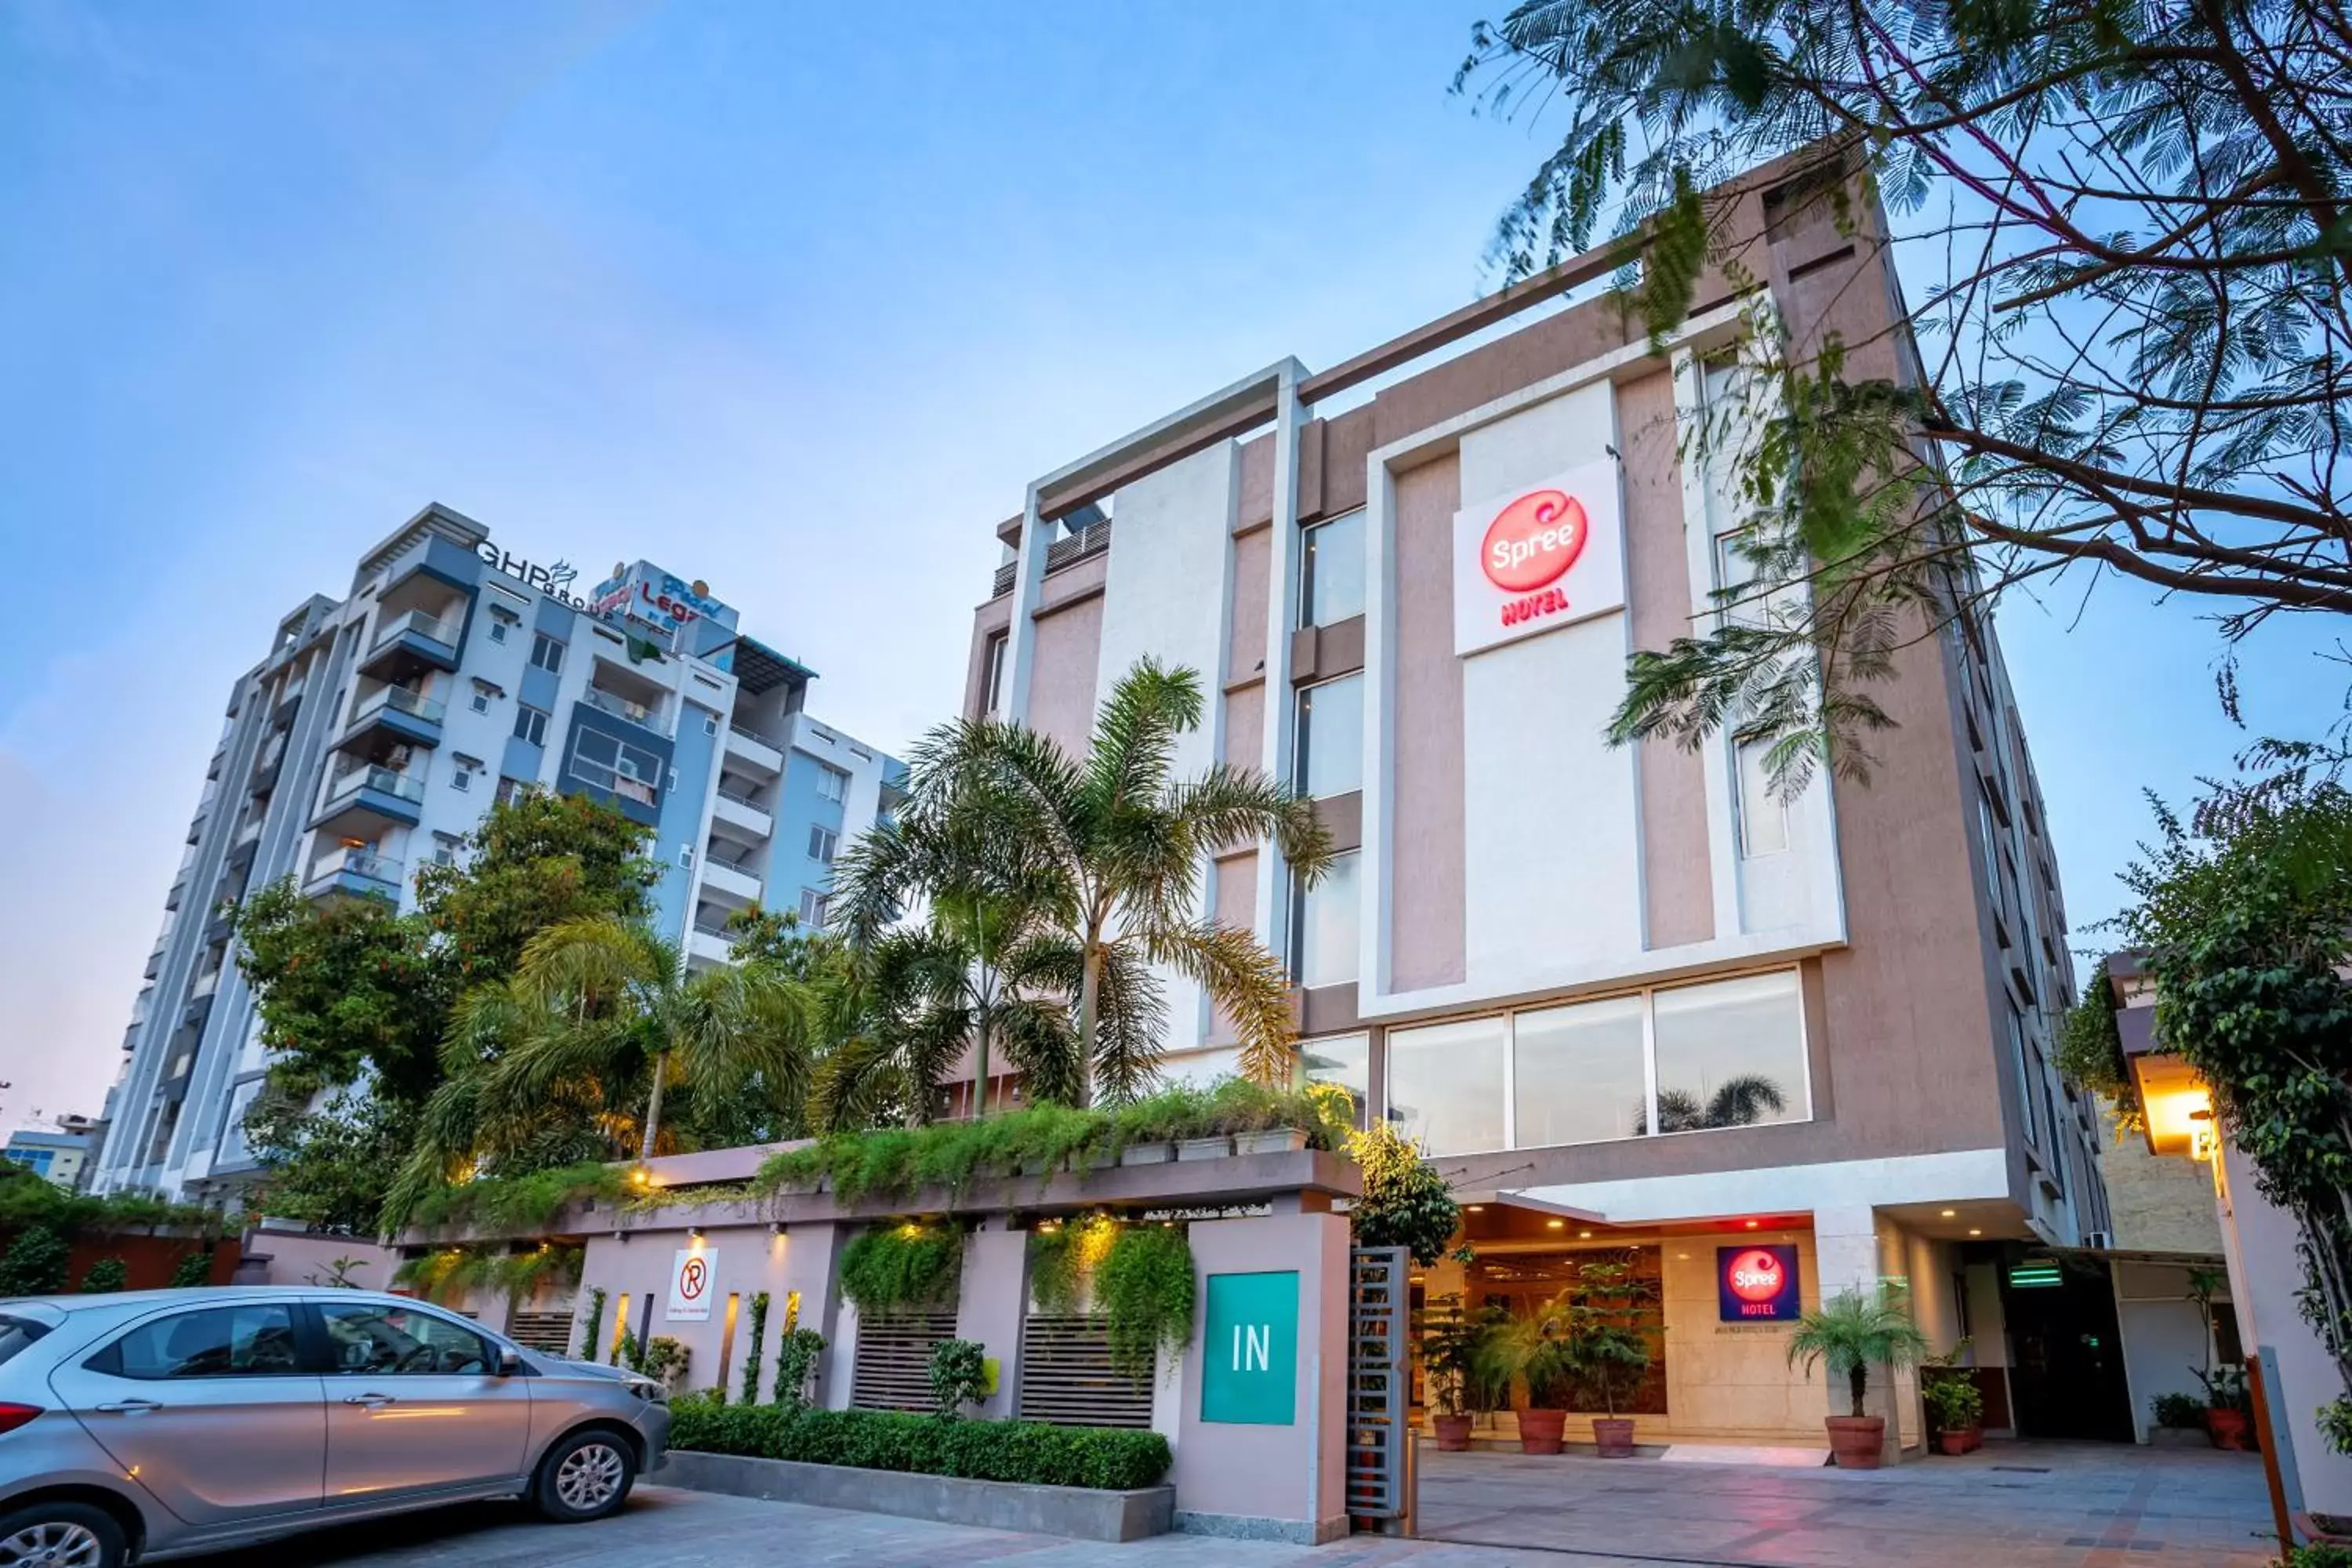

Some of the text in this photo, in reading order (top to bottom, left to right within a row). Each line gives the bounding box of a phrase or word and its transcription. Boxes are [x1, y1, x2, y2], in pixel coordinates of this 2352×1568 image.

[1492, 524, 1574, 569] Spree
[543, 583, 615, 622] GROUP
[1501, 588, 1569, 626] HOTEL
[1734, 1270, 1777, 1290] Spree
[1741, 1304, 1777, 1316] HOTEL
[1232, 1324, 1270, 1371] IN
